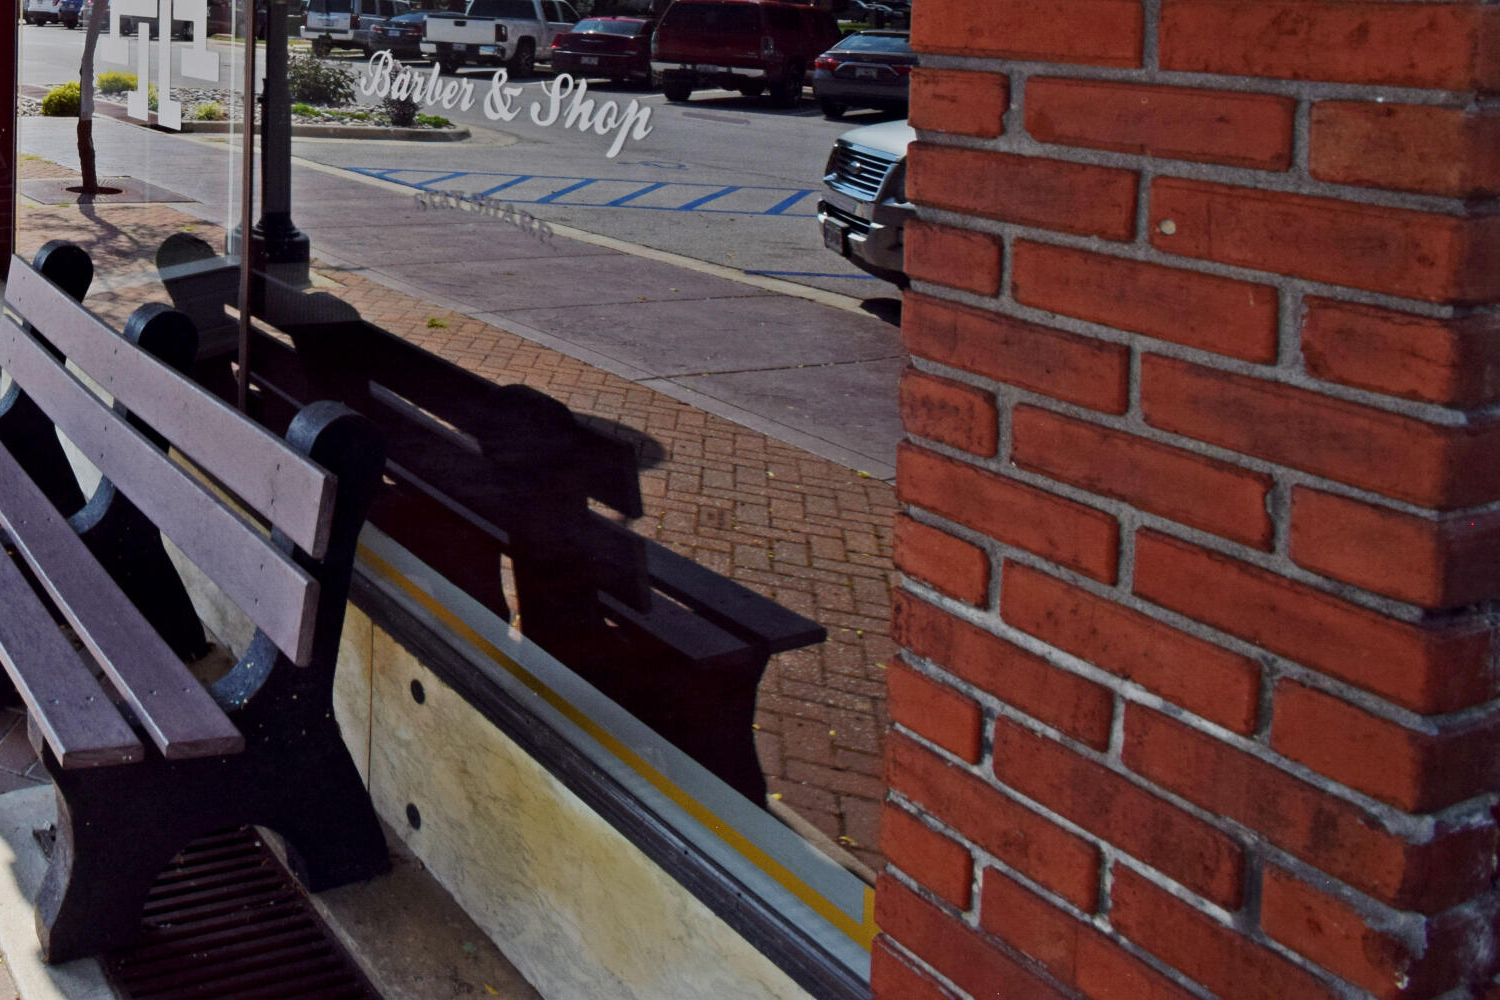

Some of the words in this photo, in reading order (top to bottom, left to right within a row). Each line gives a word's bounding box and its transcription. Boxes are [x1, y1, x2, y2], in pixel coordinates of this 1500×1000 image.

[360, 48, 476, 112] Barber
[483, 68, 525, 122] &
[530, 72, 654, 159] Shop
